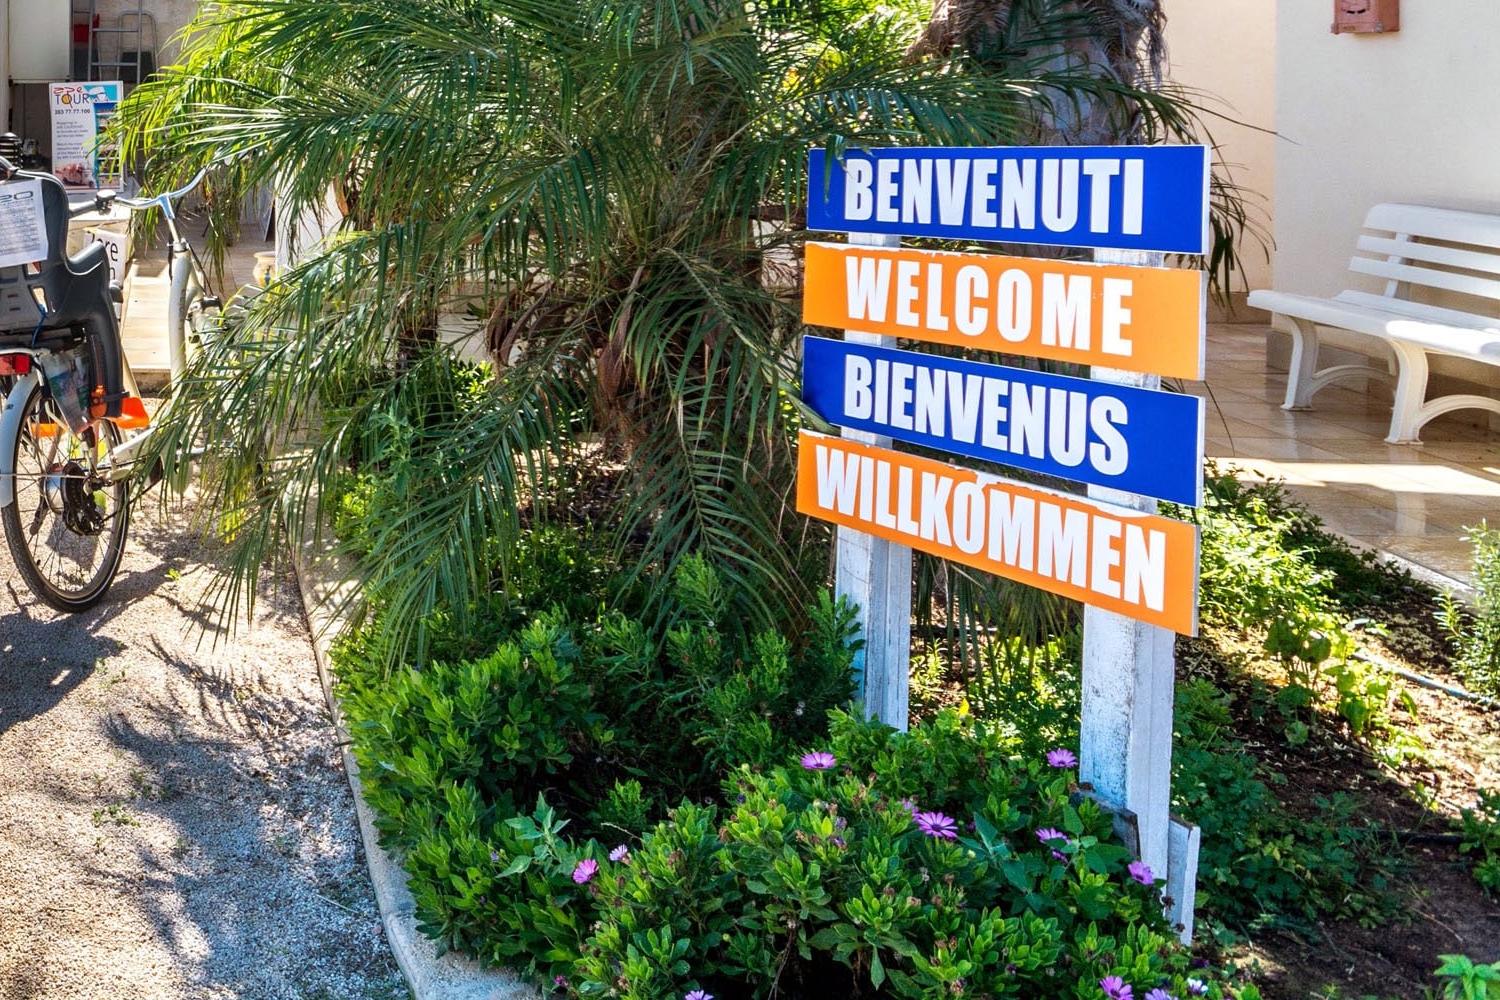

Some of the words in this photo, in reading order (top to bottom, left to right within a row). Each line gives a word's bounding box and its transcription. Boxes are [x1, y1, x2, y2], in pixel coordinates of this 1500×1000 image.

[55, 93, 90, 105] TOUR
[843, 158, 1144, 235] BENVENUTI
[845, 256, 1133, 357] WELCOME
[843, 353, 1129, 476] BIENVENUS
[815, 444, 1166, 613] WILLKOMMEN
